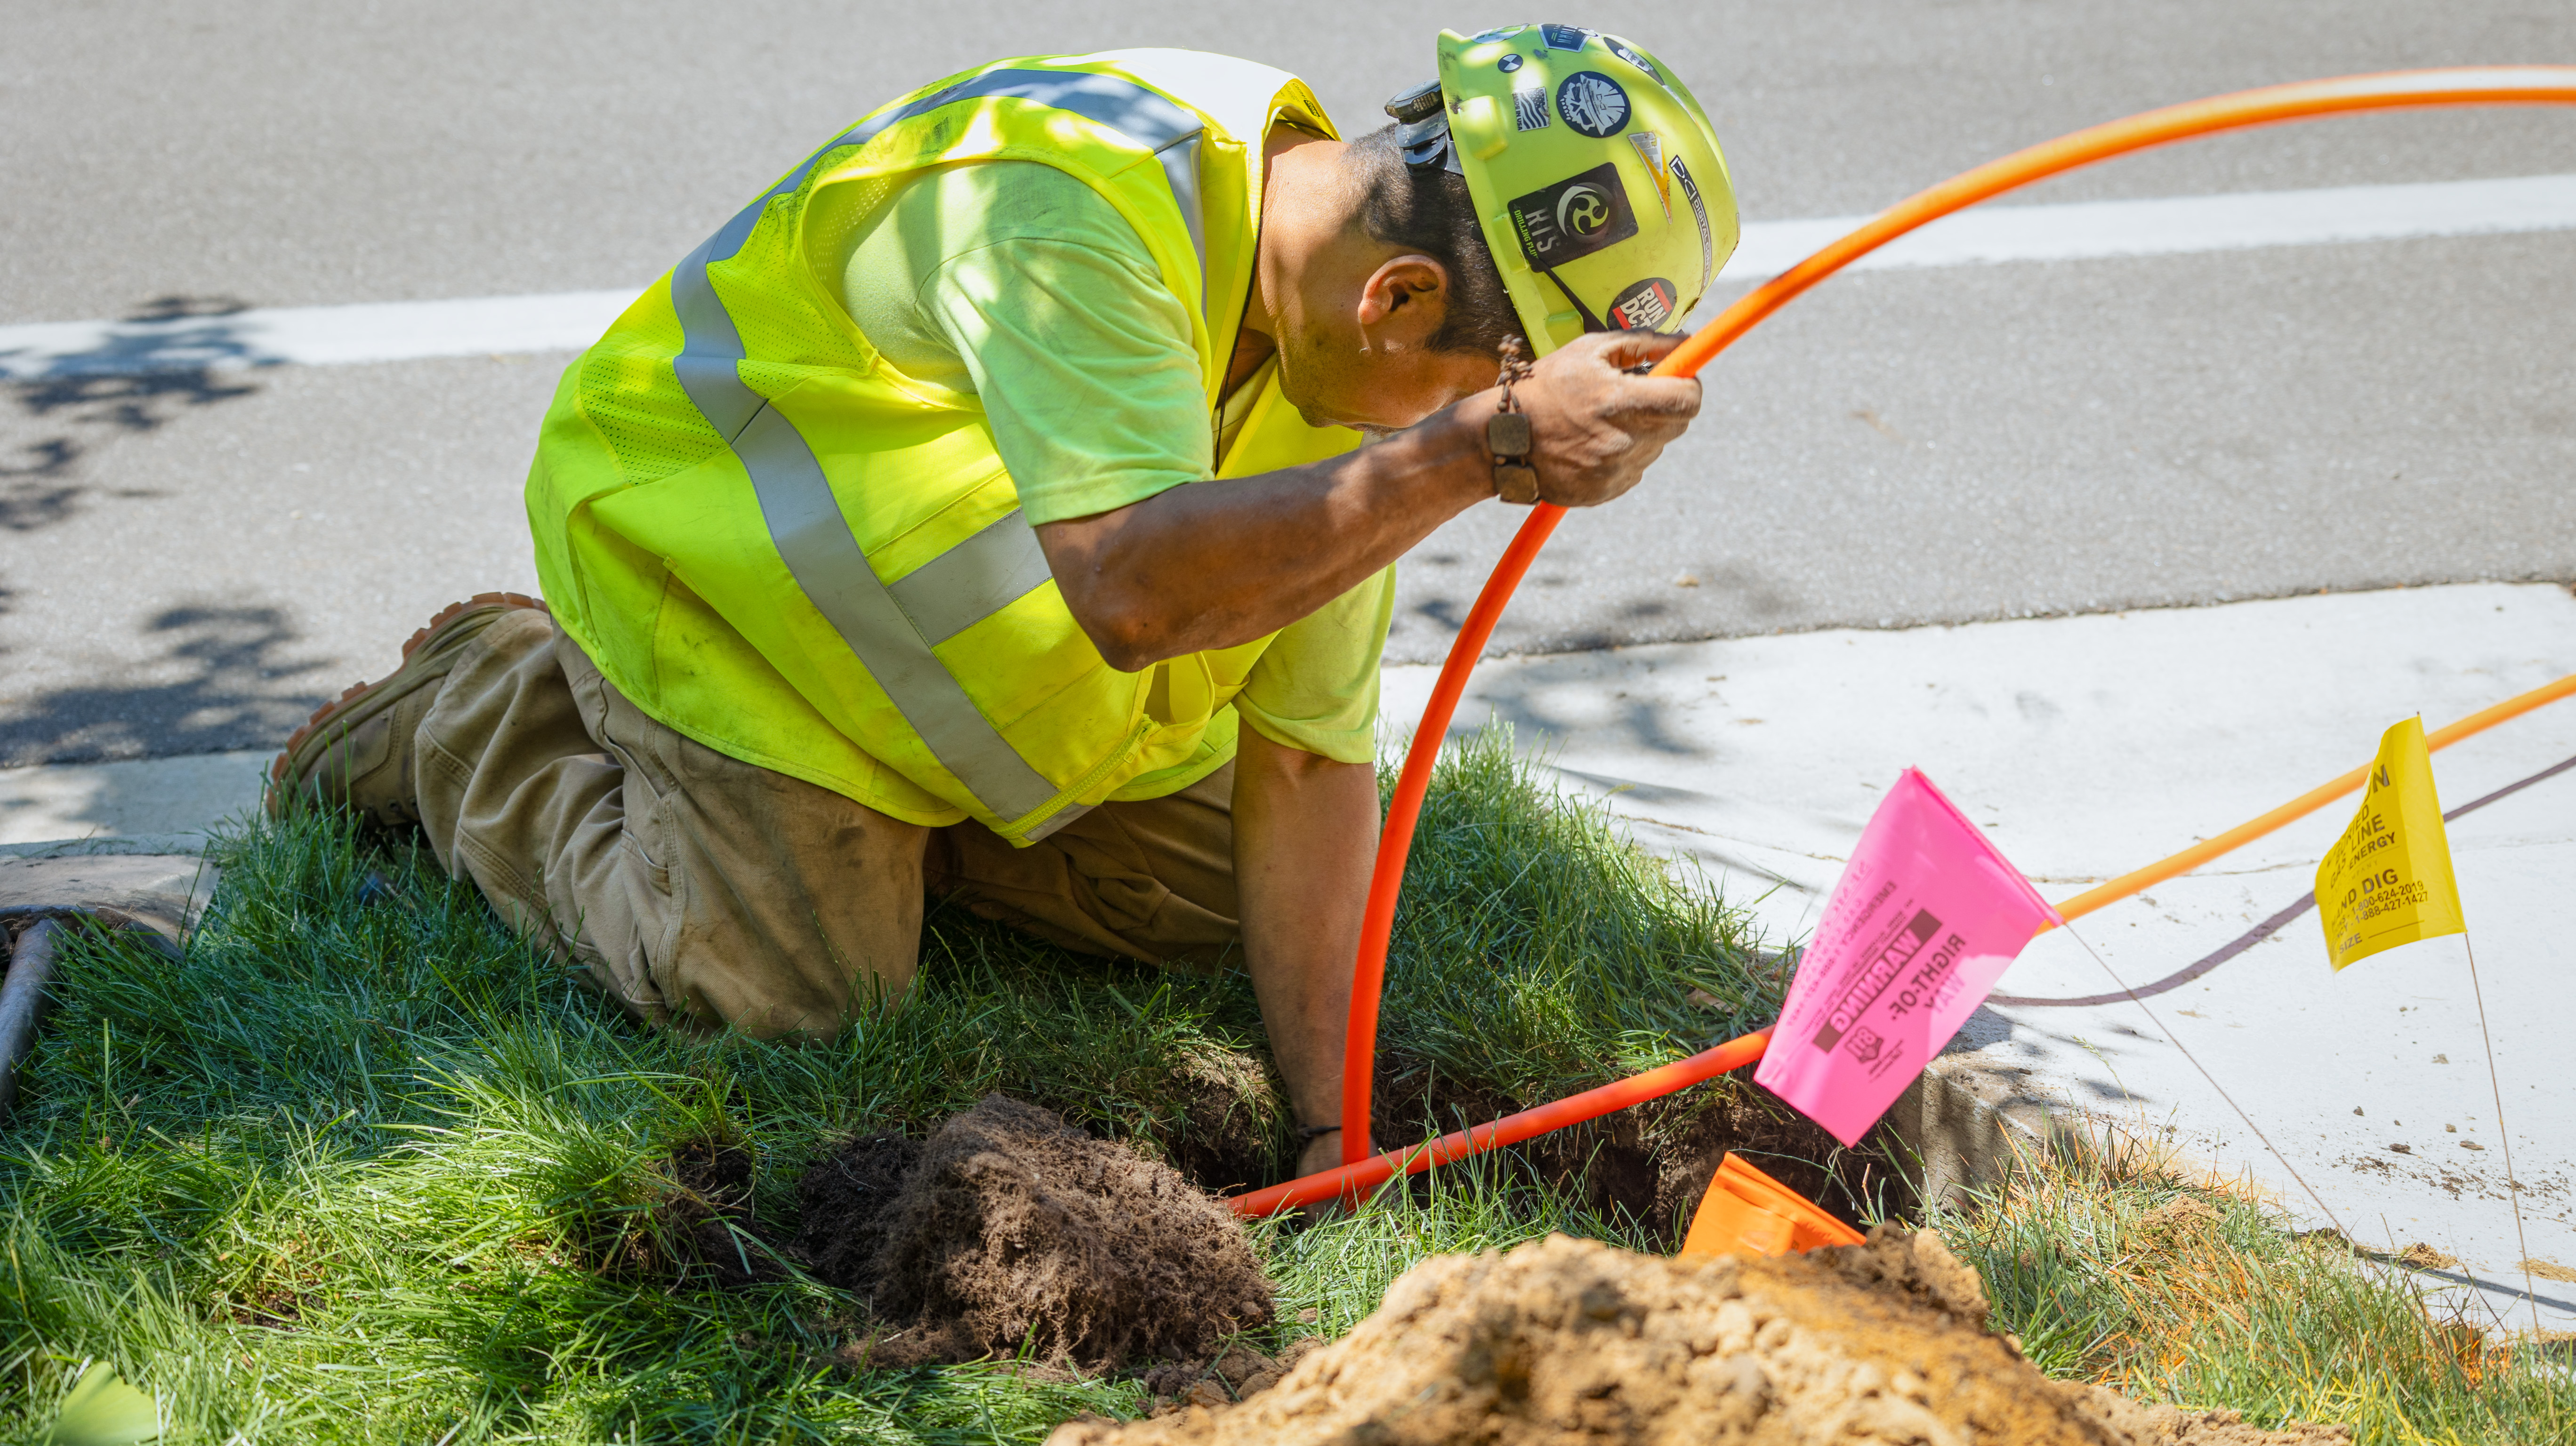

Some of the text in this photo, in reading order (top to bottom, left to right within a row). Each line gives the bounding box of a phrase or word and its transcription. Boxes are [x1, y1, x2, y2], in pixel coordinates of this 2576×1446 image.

[1292, 82, 1320, 117] CornerStone
[1514, 209, 1531, 242] DRILLING
[1694, 199, 1708, 243] DIGITAL
[1636, 286, 1666, 324] RUN
[2352, 814, 2385, 852] LINE
[2350, 831, 2395, 870] ENERGY
[2352, 881, 2423, 914] 1-800-624-2019
[2362, 869, 2398, 894] DIG
[2356, 892, 2428, 924] 1-888-427-1427
[2339, 932, 2362, 954] SIZE
